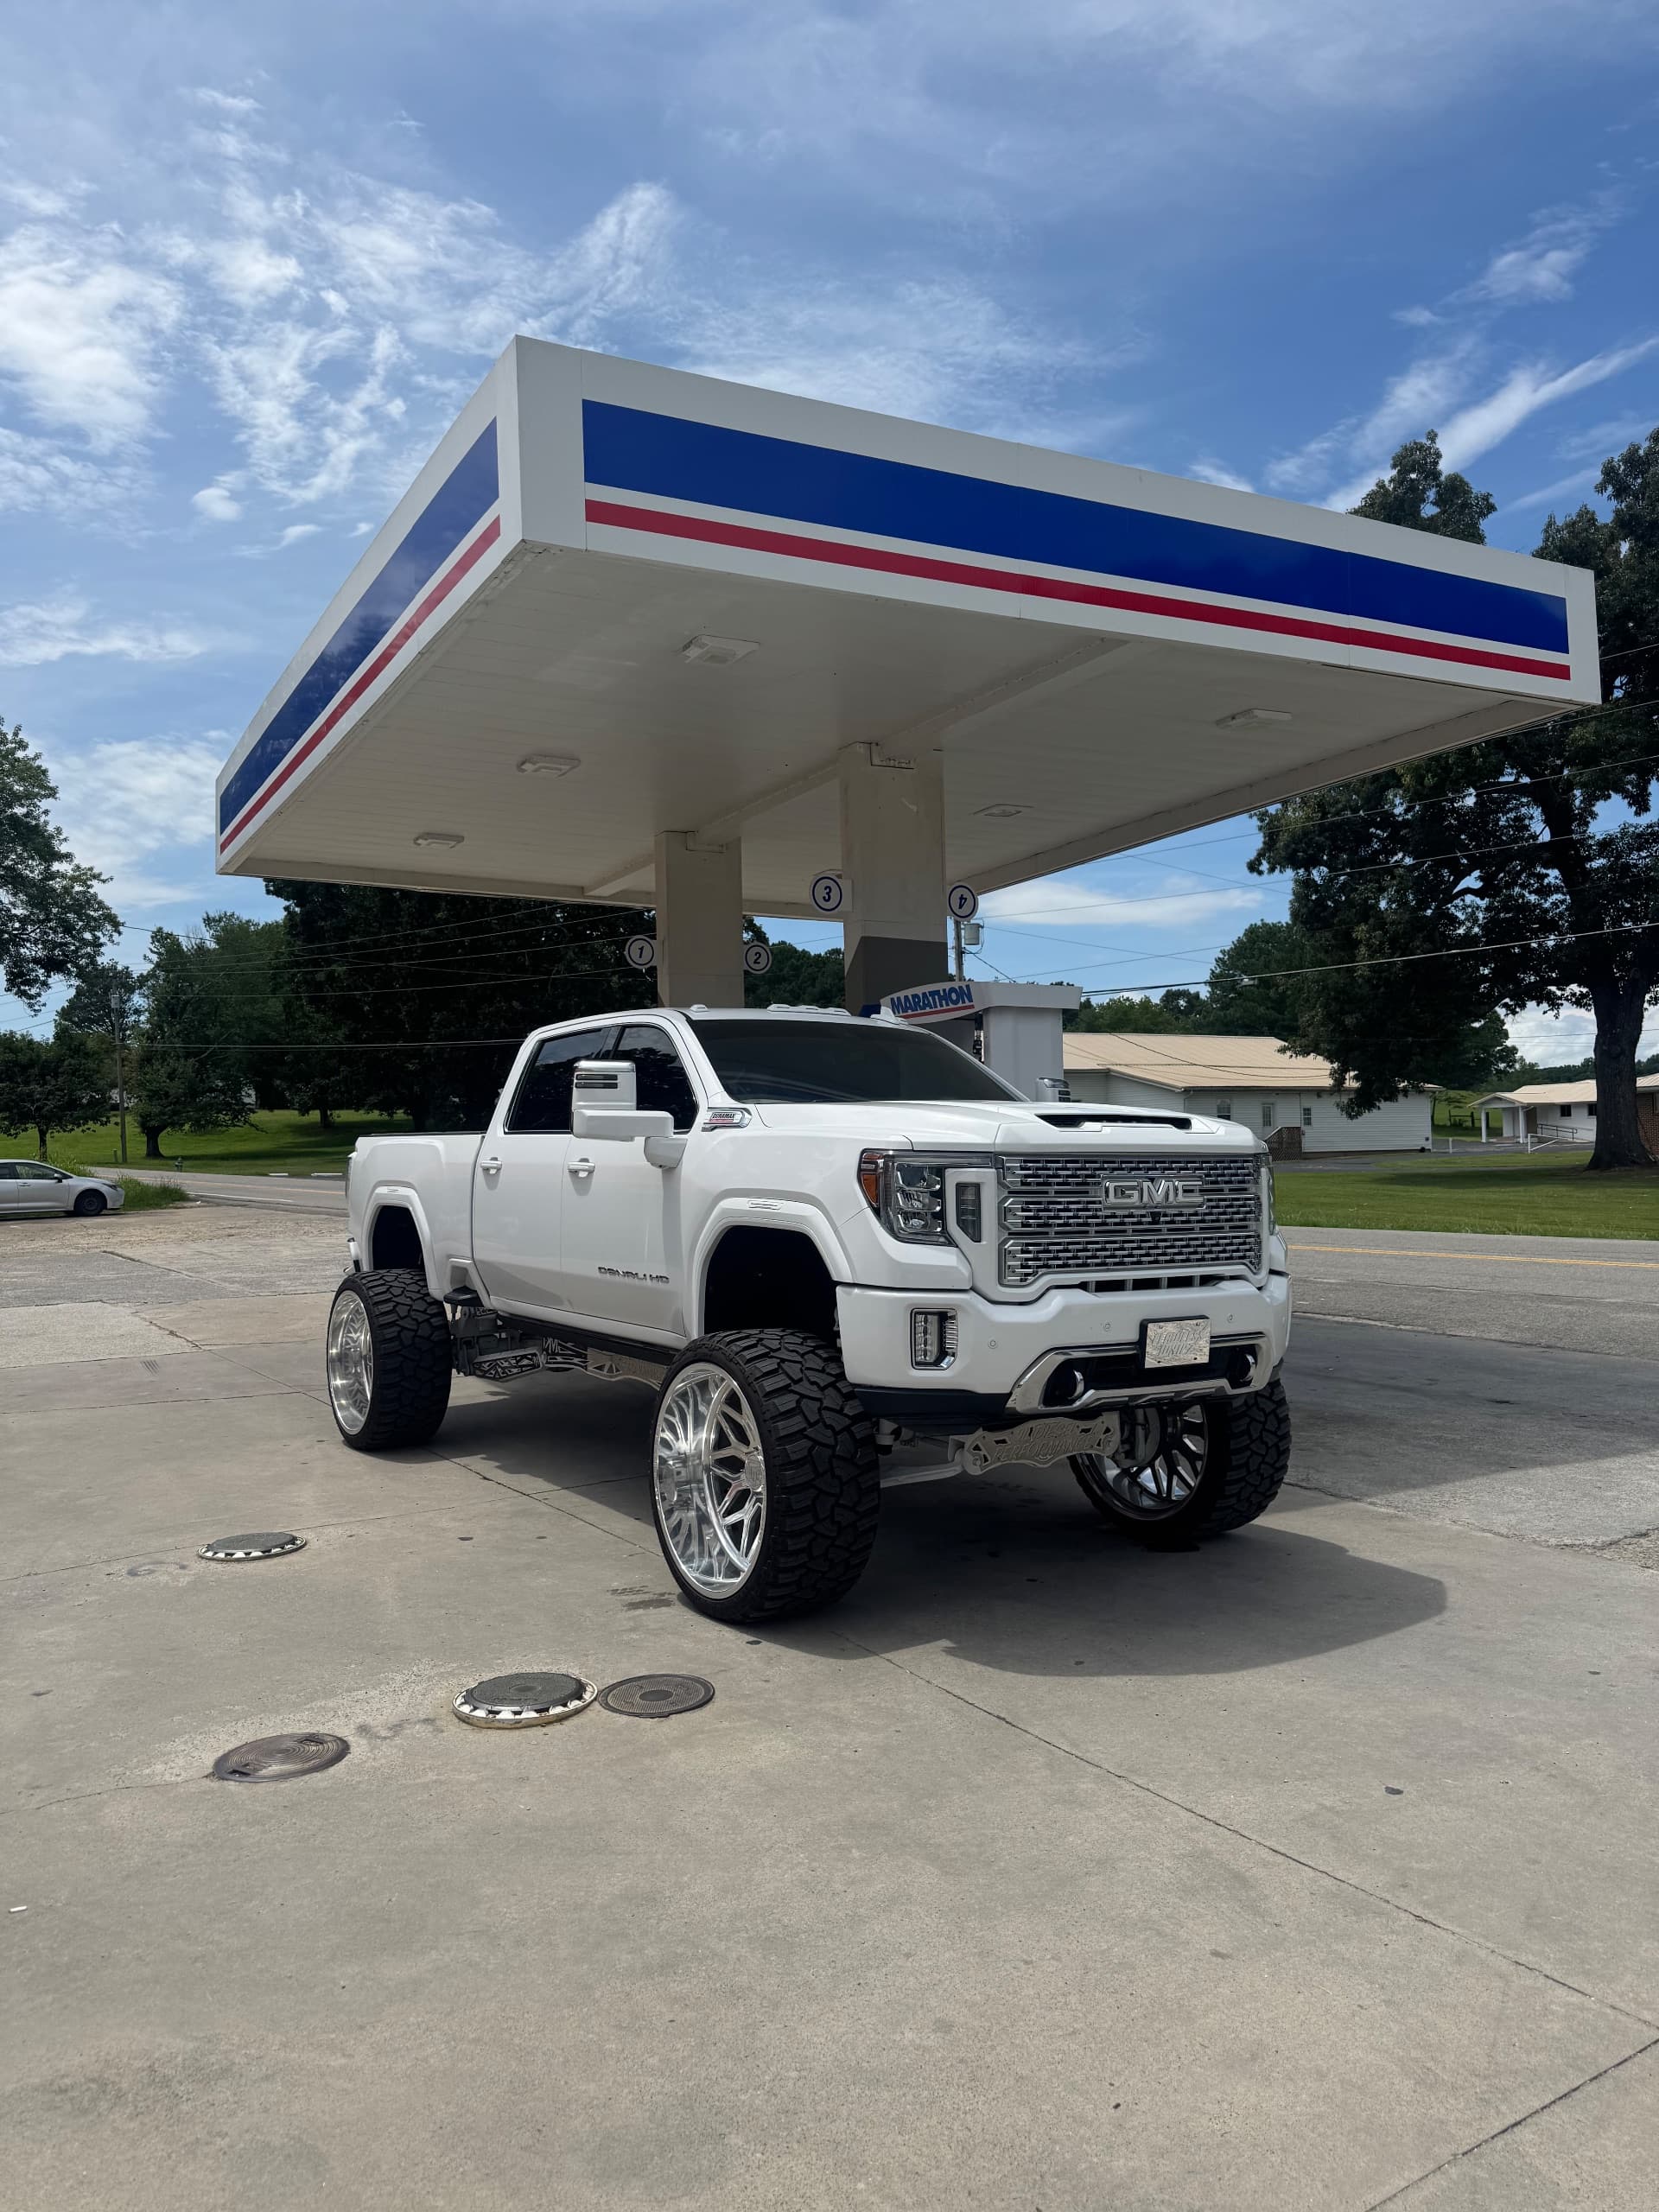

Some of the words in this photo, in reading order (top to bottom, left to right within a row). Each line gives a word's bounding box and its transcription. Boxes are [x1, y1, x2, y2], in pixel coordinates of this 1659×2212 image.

[822, 885, 832, 902] 3
[958, 893, 968, 910] 4
[638, 945, 645, 959] 1
[753, 951, 762, 964] 2
[890, 983, 974, 1015] MARATHON
[1105, 1180, 1205, 1205] GMC
[598, 1266, 647, 1281] DENALI
[649, 1274, 670, 1284] HD
